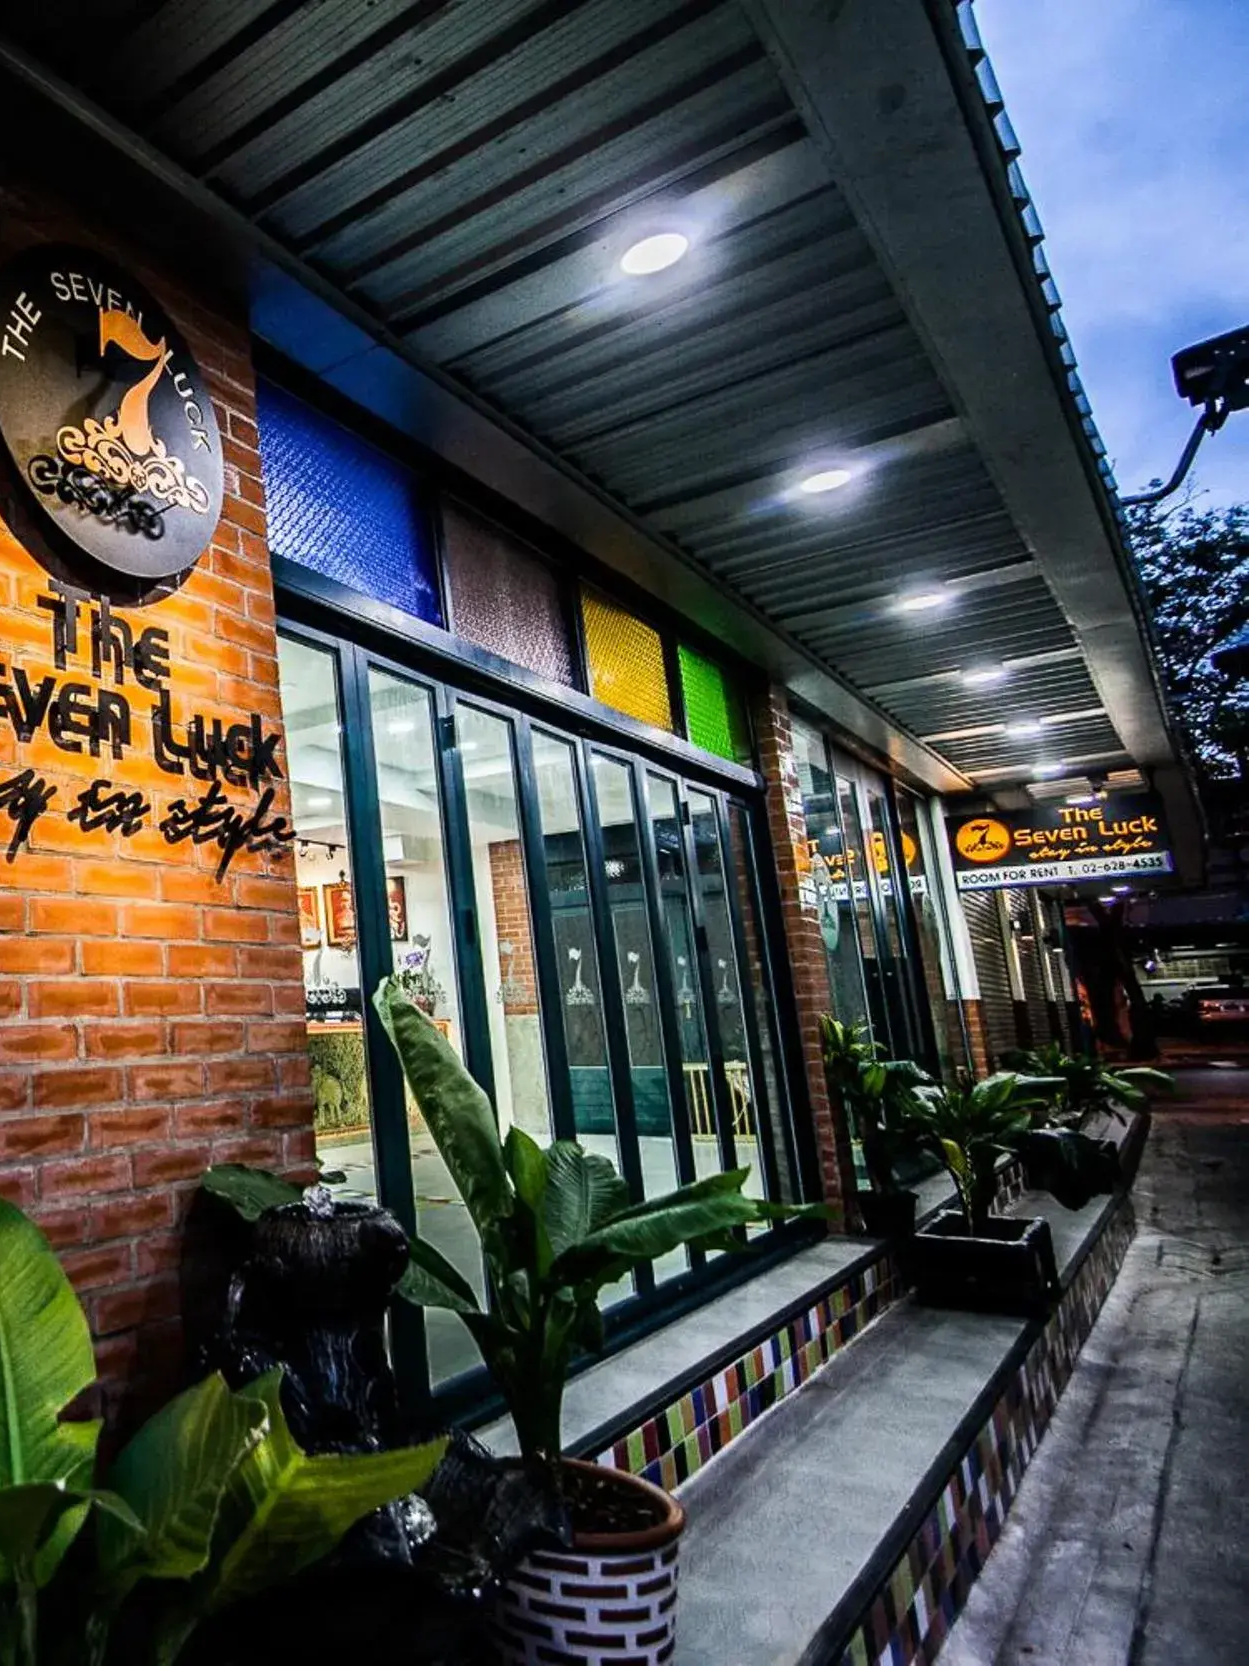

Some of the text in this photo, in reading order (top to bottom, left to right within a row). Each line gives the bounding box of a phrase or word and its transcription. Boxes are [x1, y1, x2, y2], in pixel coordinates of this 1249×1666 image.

[2, 291, 42, 362] THE
[38, 579, 171, 689] The
[1058, 806, 1104, 824] The
[1098, 815, 1159, 836] Luck
[1028, 835, 1154, 861] stay in style
[961, 871, 1001, 886] ROOM
[1002, 867, 1027, 882] FOR
[1030, 865, 1059, 880] RENT
[1081, 856, 1164, 874] 02-628-4535
